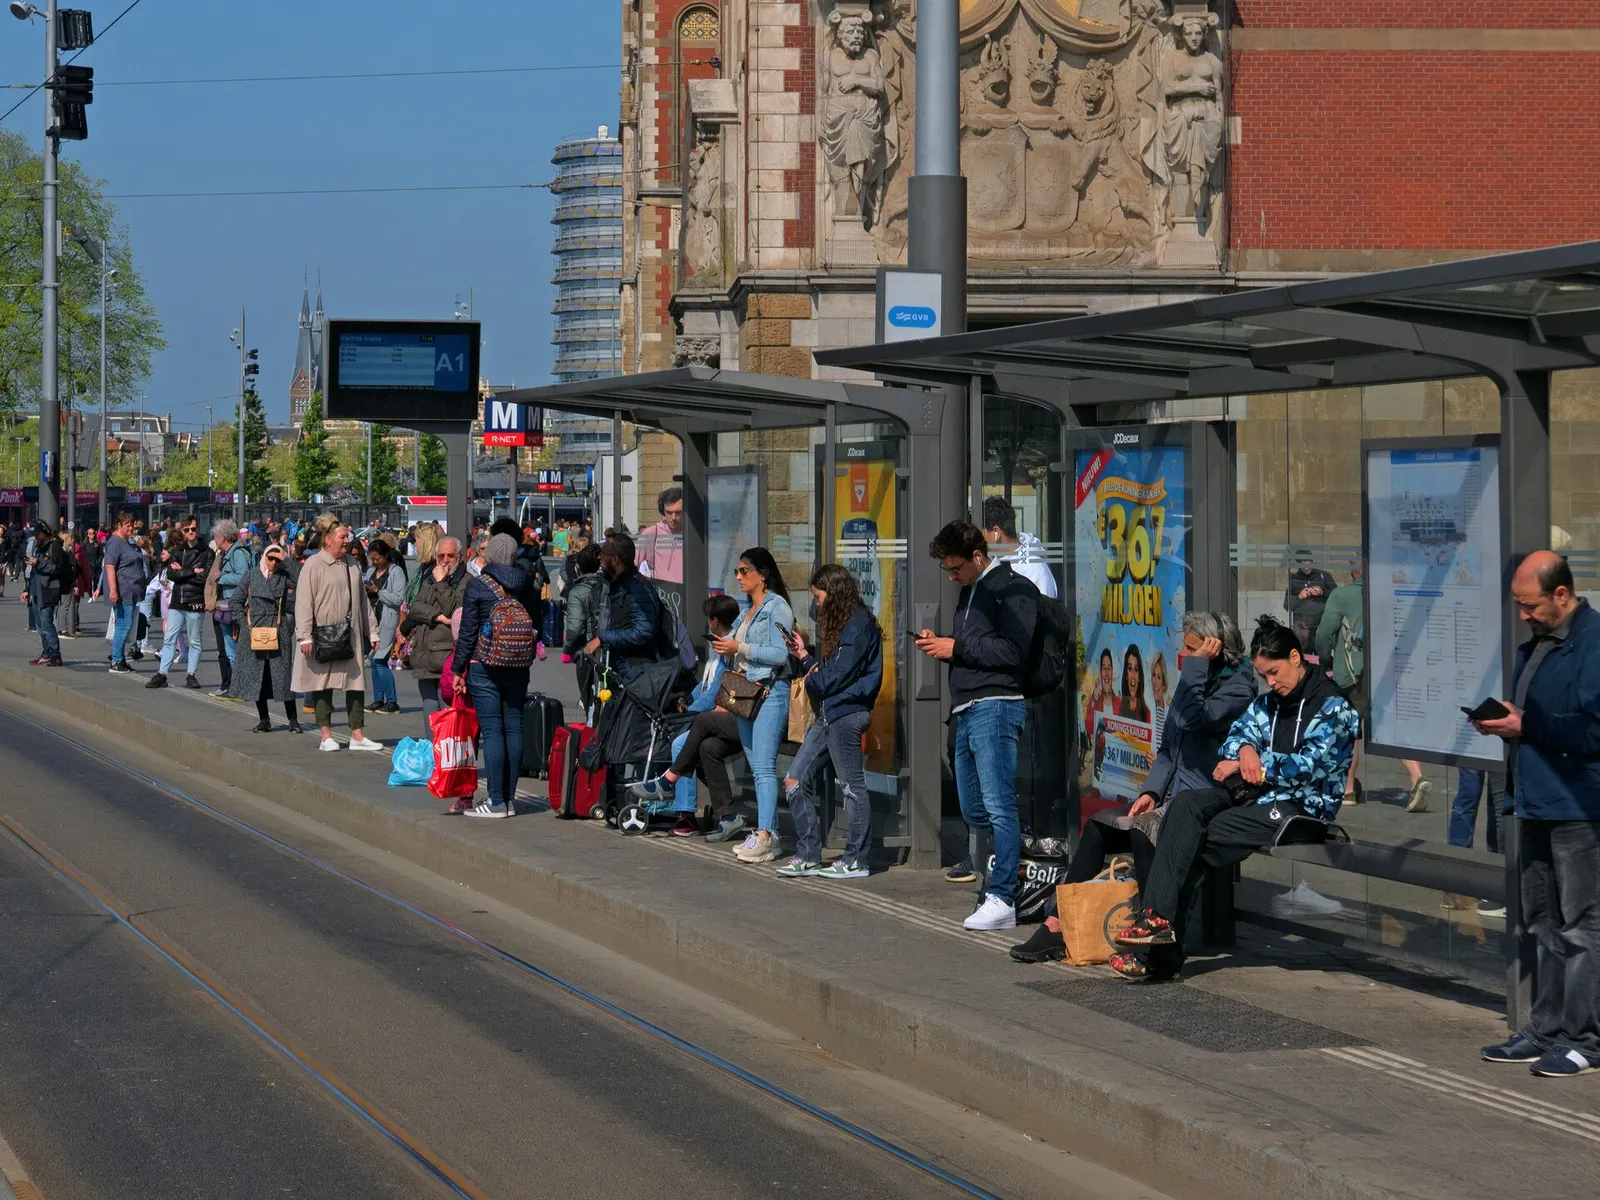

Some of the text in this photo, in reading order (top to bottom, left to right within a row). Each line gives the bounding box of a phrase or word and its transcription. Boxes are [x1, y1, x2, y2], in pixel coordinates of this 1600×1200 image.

[435, 352, 464, 372] A1
[492, 401, 518, 430] M
[527, 406, 541, 430] M
[1113, 433, 1140, 444] JCDecaux
[539, 471, 547, 483] M
[550, 471, 561, 483] M
[1081, 455, 1101, 493] NIEUW!
[848, 558, 873, 576] 20 jaar
[1102, 583, 1162, 627] MILJOEN
[1120, 749, 1149, 771] MILJOEN
[1026, 862, 1057, 884] Gall
